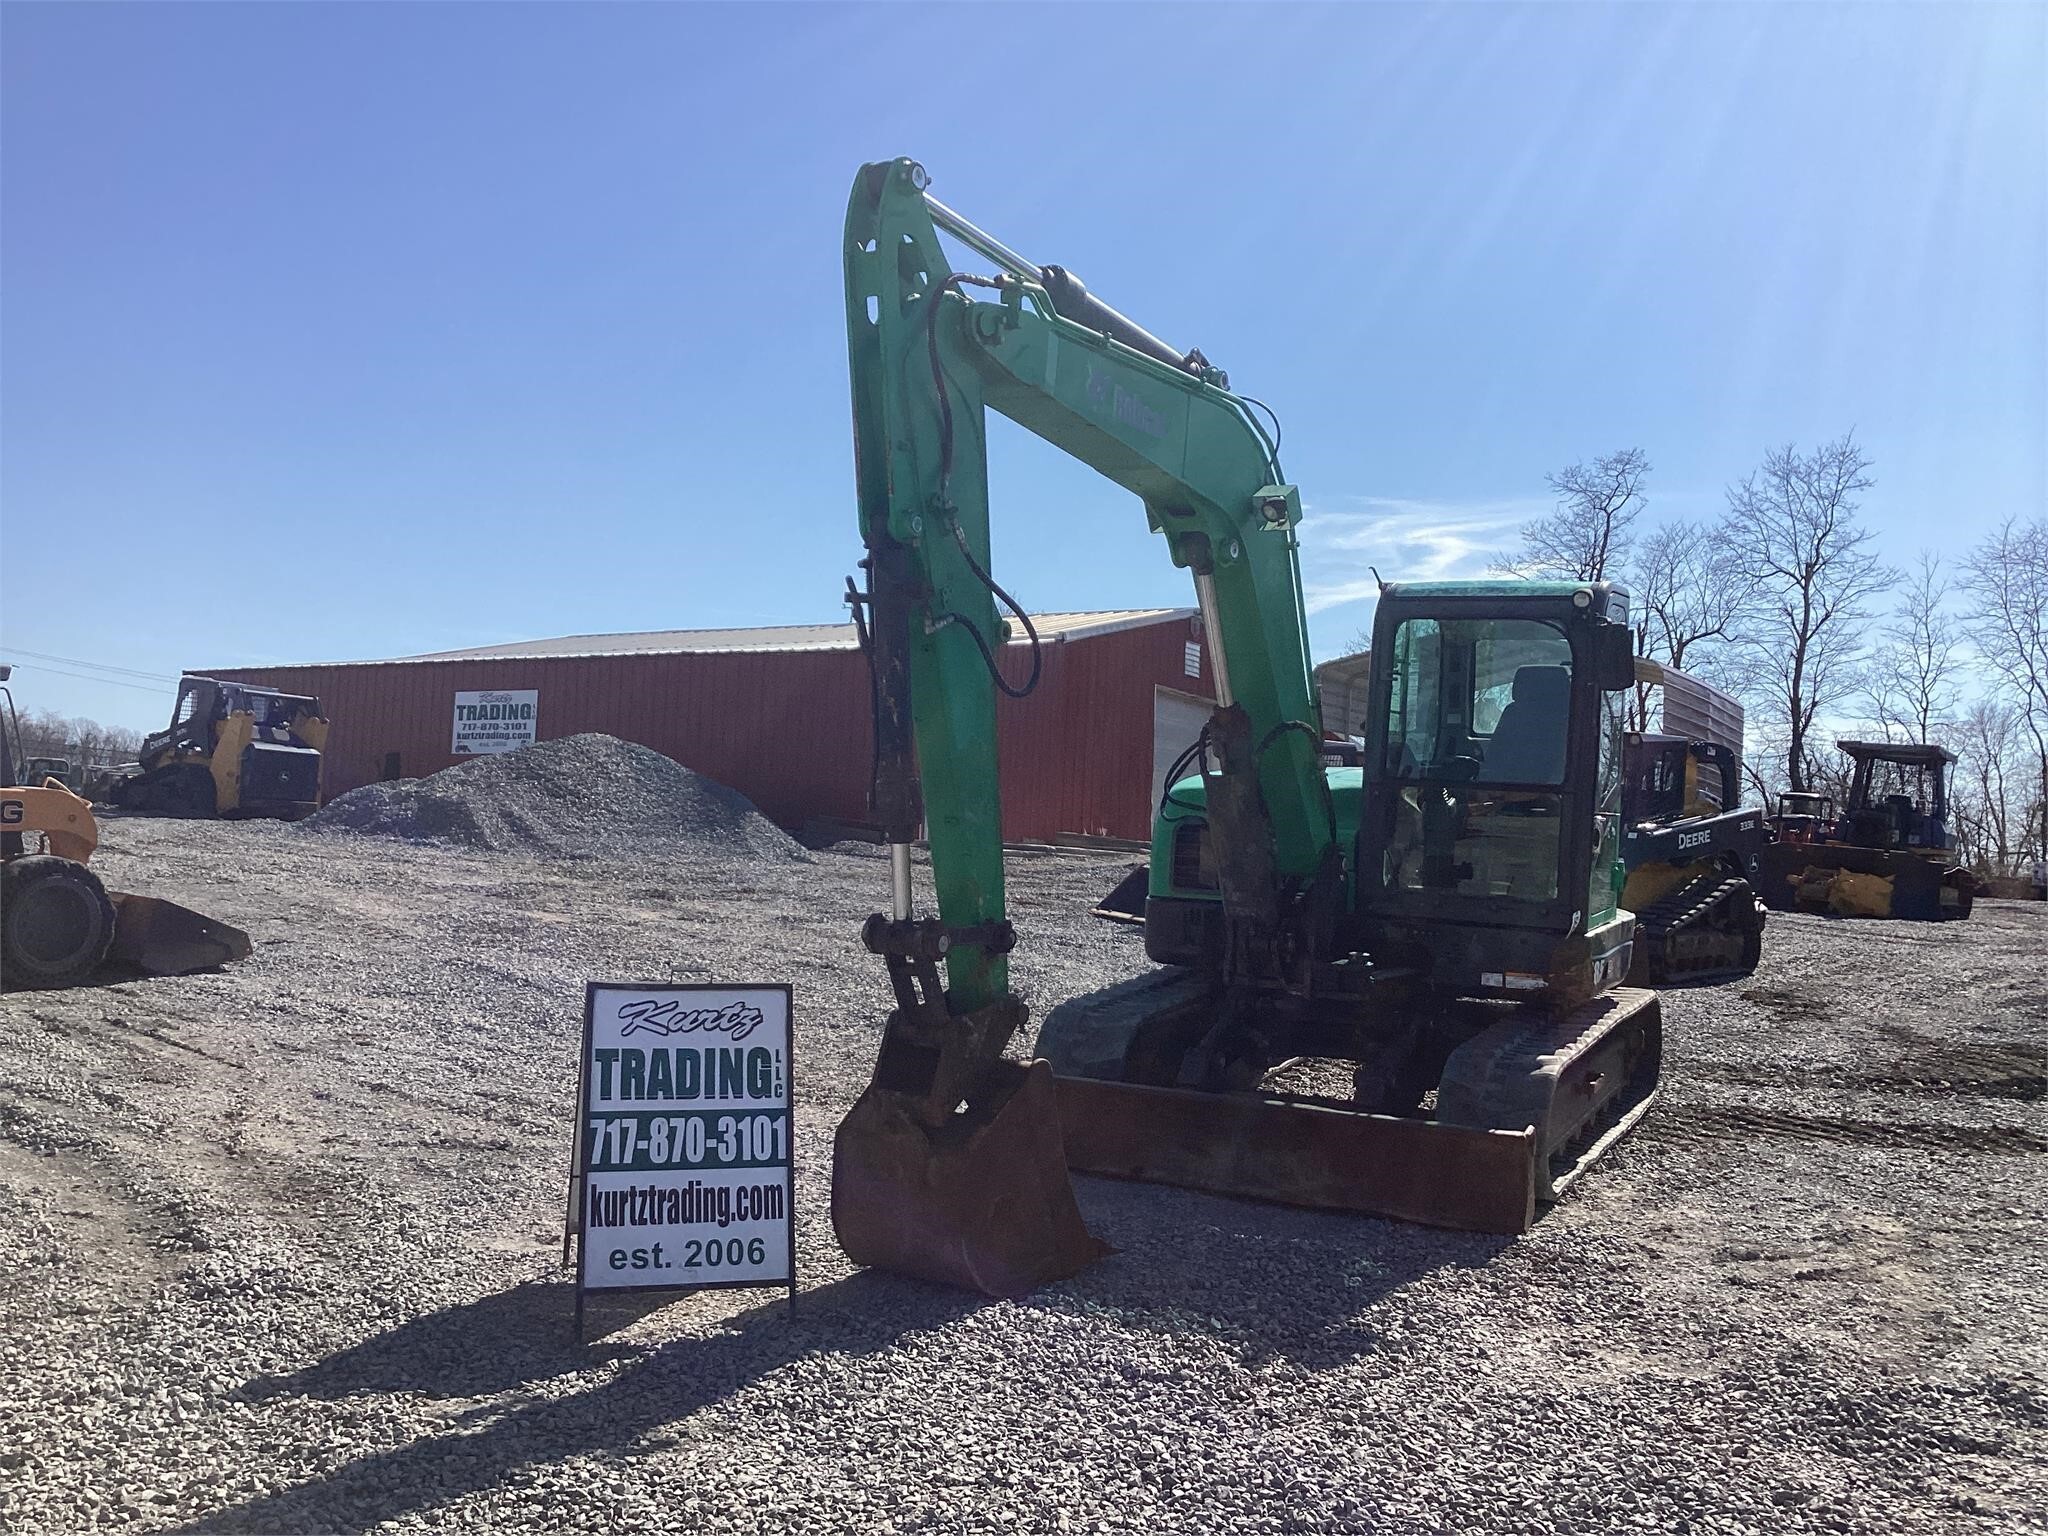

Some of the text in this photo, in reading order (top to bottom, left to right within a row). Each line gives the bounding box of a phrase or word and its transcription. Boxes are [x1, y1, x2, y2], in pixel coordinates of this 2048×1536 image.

[456, 703, 531, 720] TRADING
[462, 722, 527, 731] 717-870-3101
[456, 731, 531, 741] kurtztrading.com
[1678, 830, 1711, 850] DEERE
[618, 1000, 764, 1041] Kurtz
[594, 1046, 772, 1101] TRADING
[775, 1049, 783, 1098] LLC
[590, 1115, 787, 1165] 717-870-3101
[590, 1180, 784, 1228] kurtztrading.com
[609, 1238, 765, 1270] est. 2006
